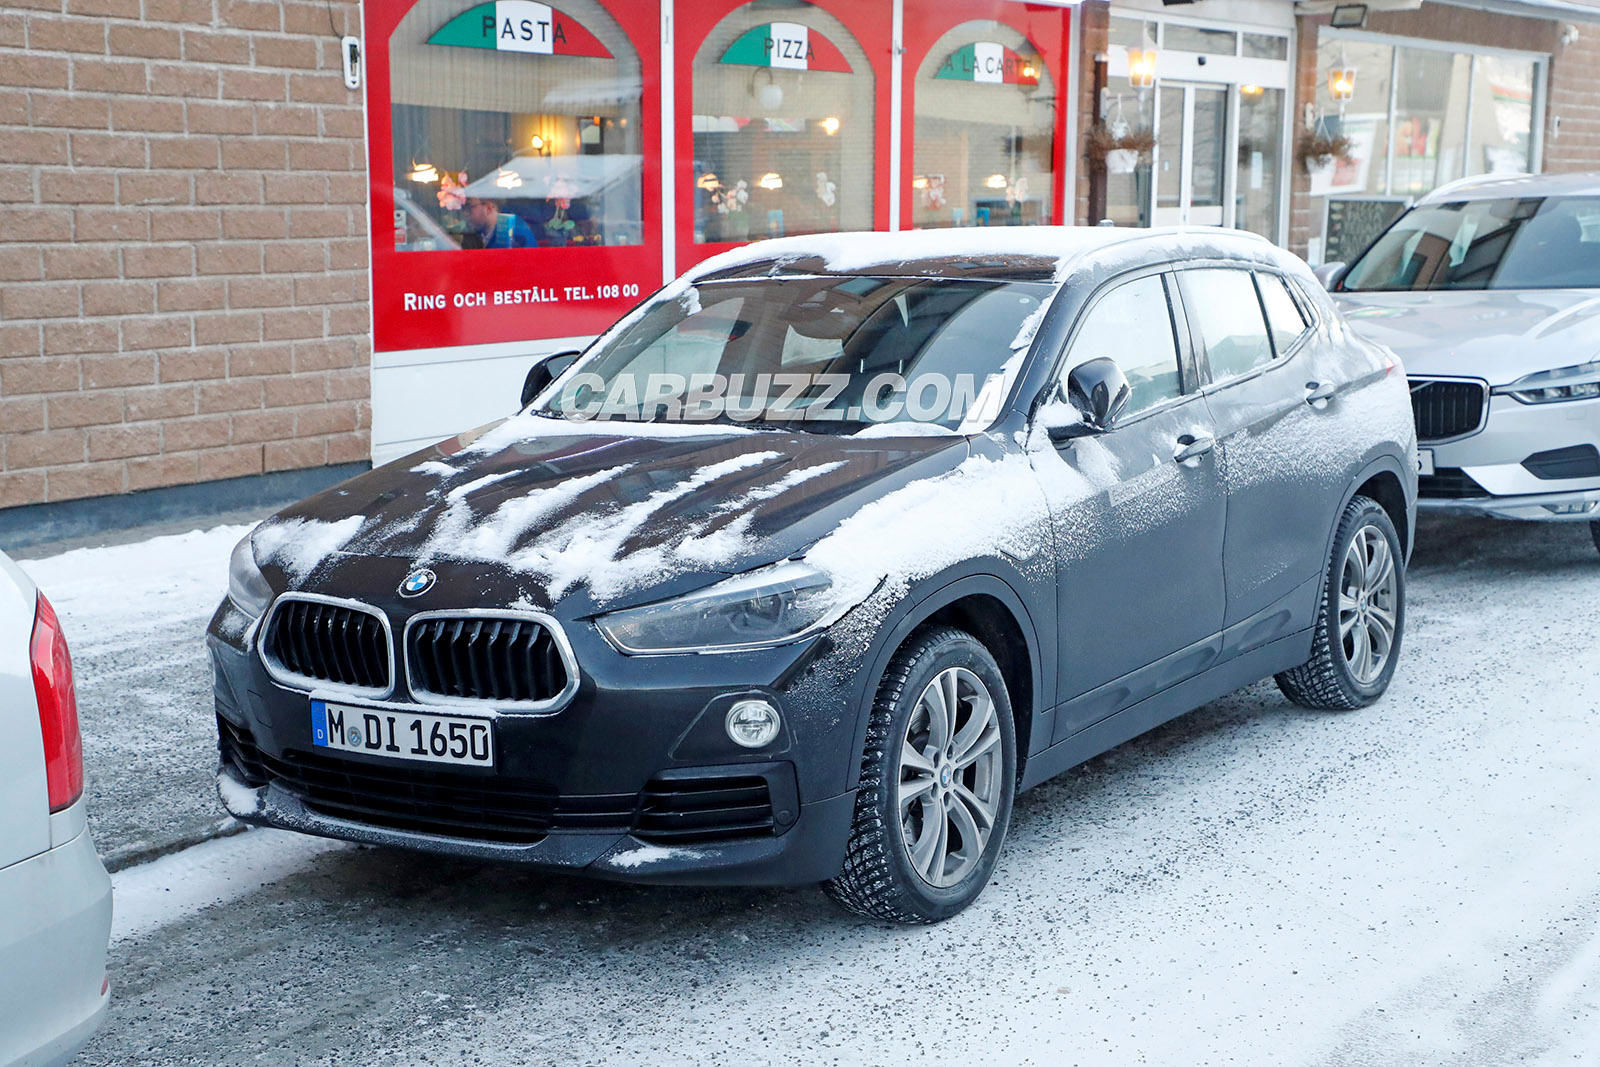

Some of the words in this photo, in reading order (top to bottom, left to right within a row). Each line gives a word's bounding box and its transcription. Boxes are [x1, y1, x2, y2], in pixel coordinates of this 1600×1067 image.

[482, 15, 567, 43] PASTA
[763, 37, 815, 61] PIZZA
[962, 55, 981, 73] LA
[453, 292, 487, 308] OCH
[493, 286, 558, 304] BESTÄLL
[317, 729, 324, 740] D
[328, 708, 345, 745] M
[363, 713, 400, 753] DI
[410, 719, 489, 761] 1650
